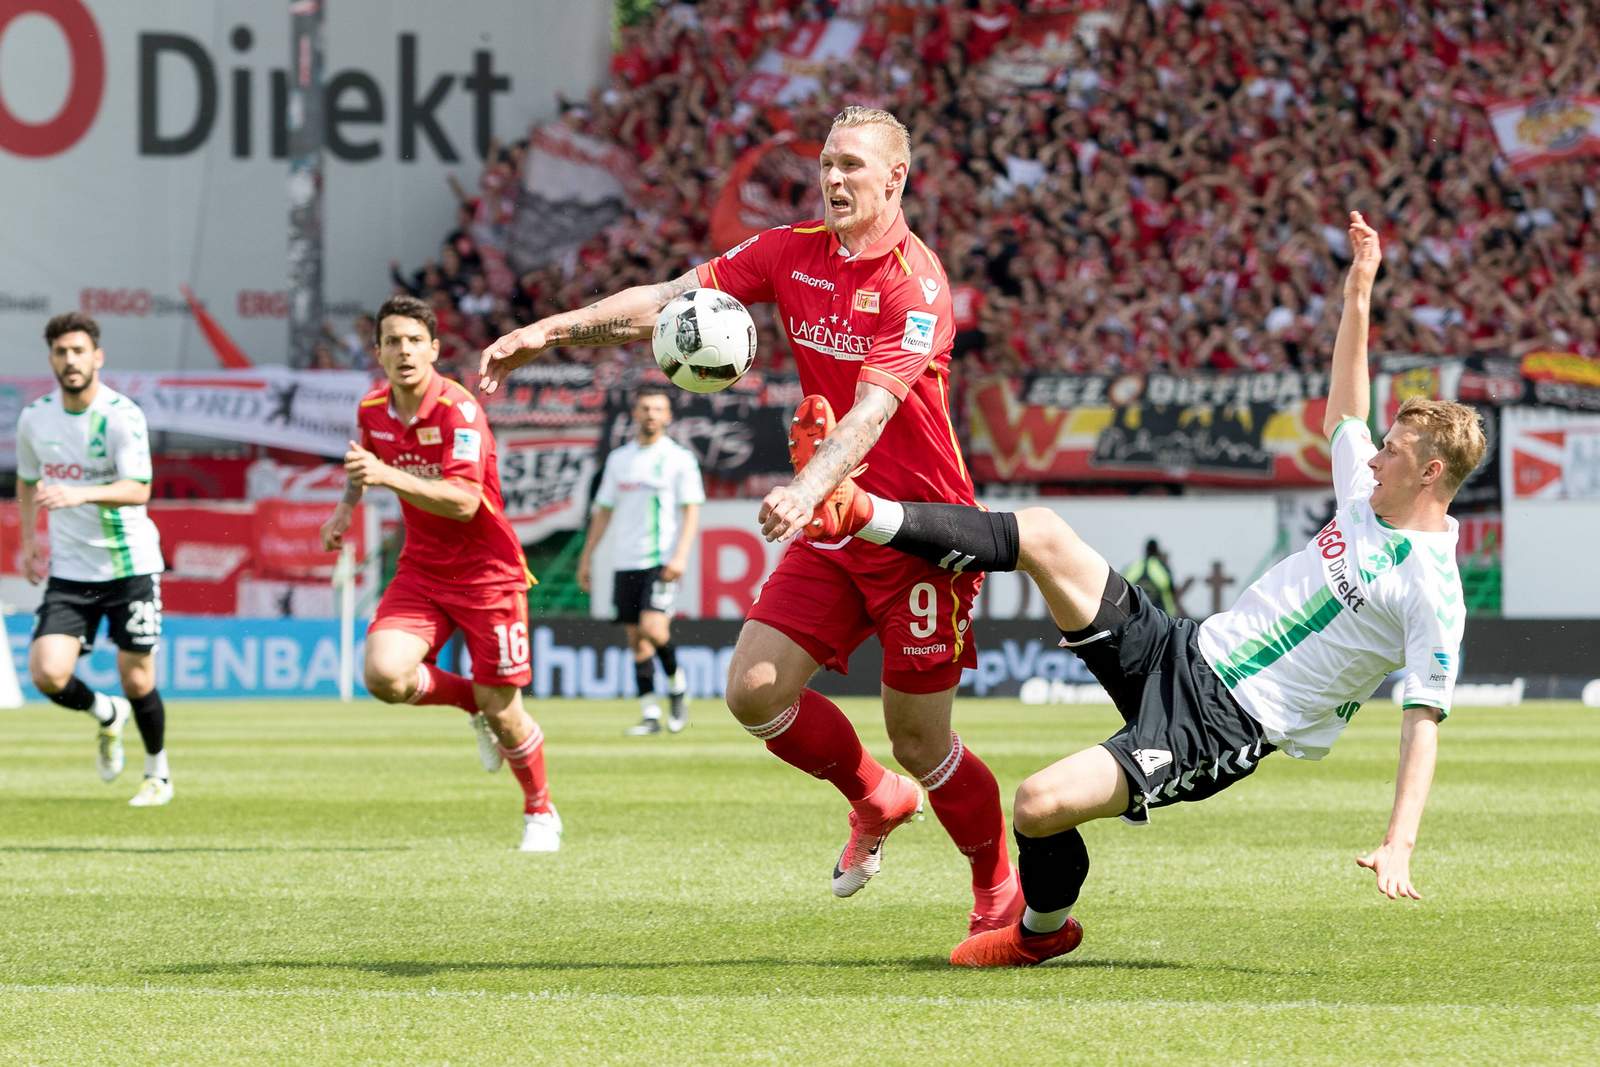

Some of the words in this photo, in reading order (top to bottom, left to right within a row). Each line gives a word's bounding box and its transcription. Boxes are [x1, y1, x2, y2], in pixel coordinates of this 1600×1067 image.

[791, 270, 835, 292] macron
[1316, 520, 1346, 559] RGO
[1328, 558, 1365, 613] Direkt
[908, 582, 938, 638] 9
[493, 621, 529, 667] 16
[903, 643, 946, 655] macron
